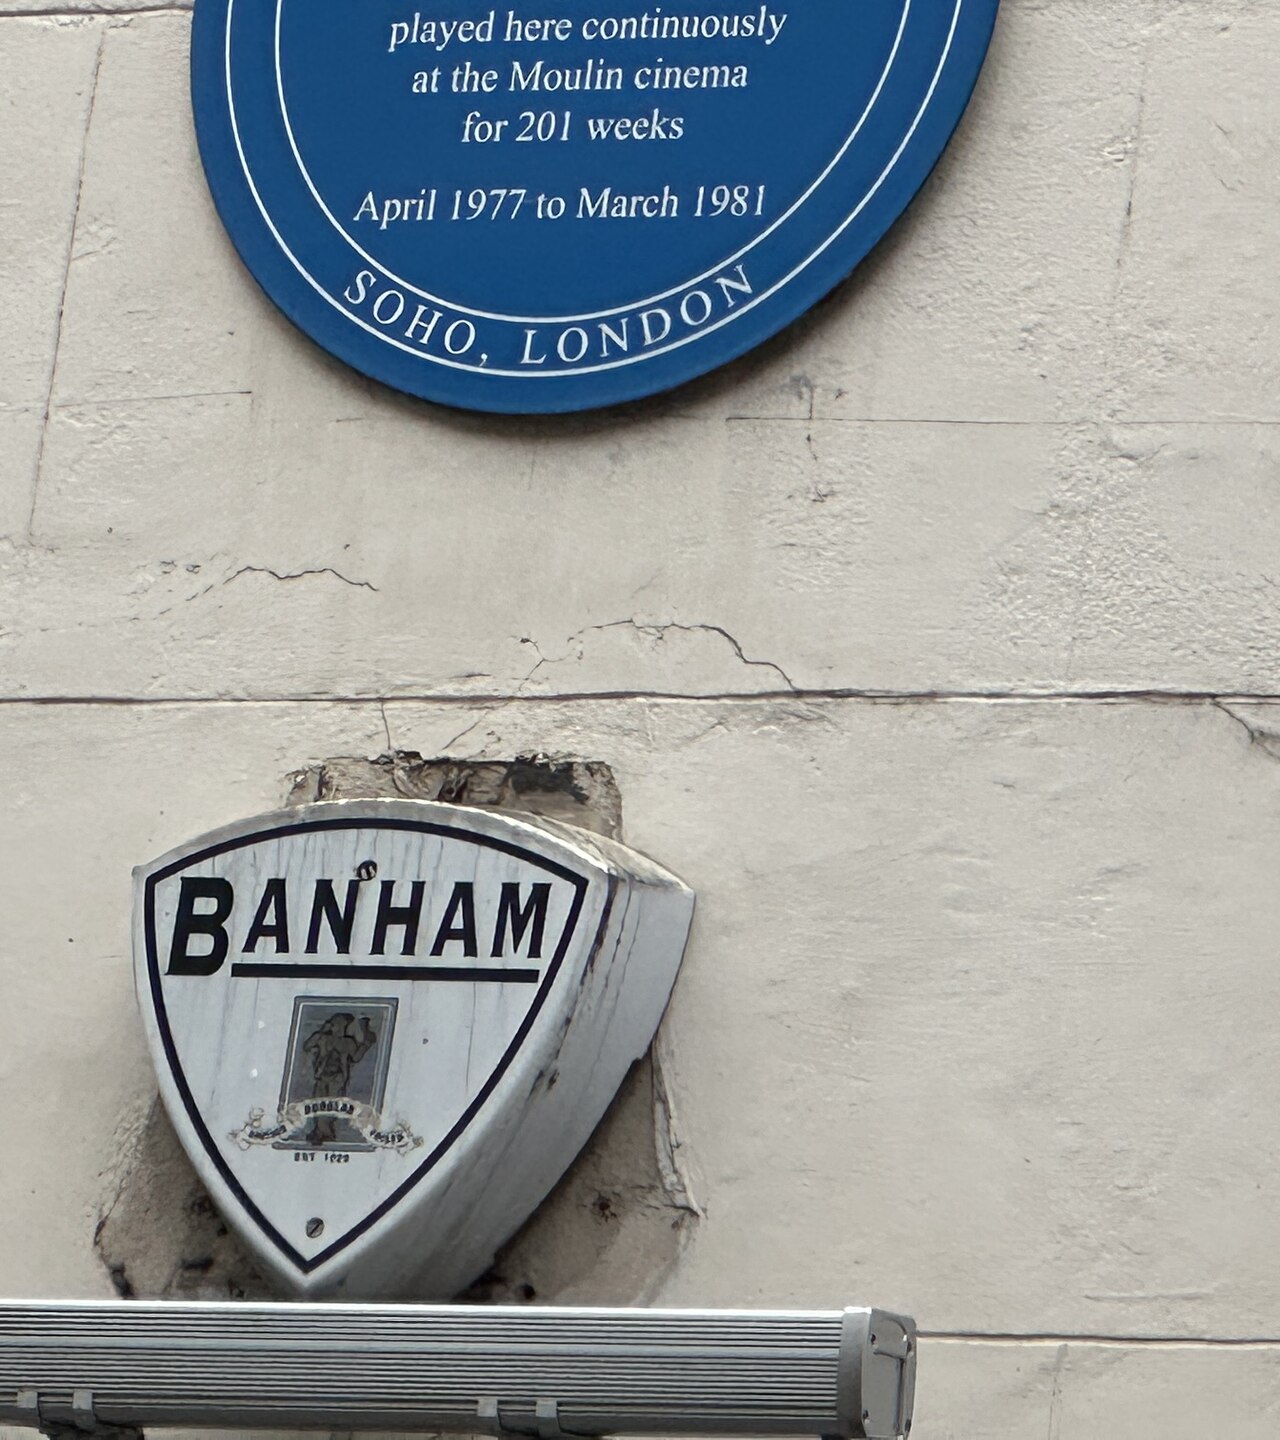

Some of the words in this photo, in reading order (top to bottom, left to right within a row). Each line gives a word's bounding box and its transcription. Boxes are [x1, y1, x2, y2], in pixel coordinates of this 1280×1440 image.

[389, 11, 494, 52] played
[504, 11, 572, 41] here
[583, 5, 787, 44] continuously
[413, 68, 441, 93] at
[452, 62, 498, 92] the
[509, 59, 622, 91] Moulin
[634, 58, 747, 89] cinema
[462, 111, 508, 142] for
[516, 111, 570, 141] 201
[588, 108, 683, 140] weeks
[353, 189, 436, 229] April
[452, 189, 526, 220] 1977
[537, 194, 565, 218] to
[577, 186, 678, 218] March
[695, 185, 764, 216] 1981
[344, 271, 487, 366] SOHO,
[521, 265, 752, 363] LONDON
[165, 876, 552, 976] BANHAM
